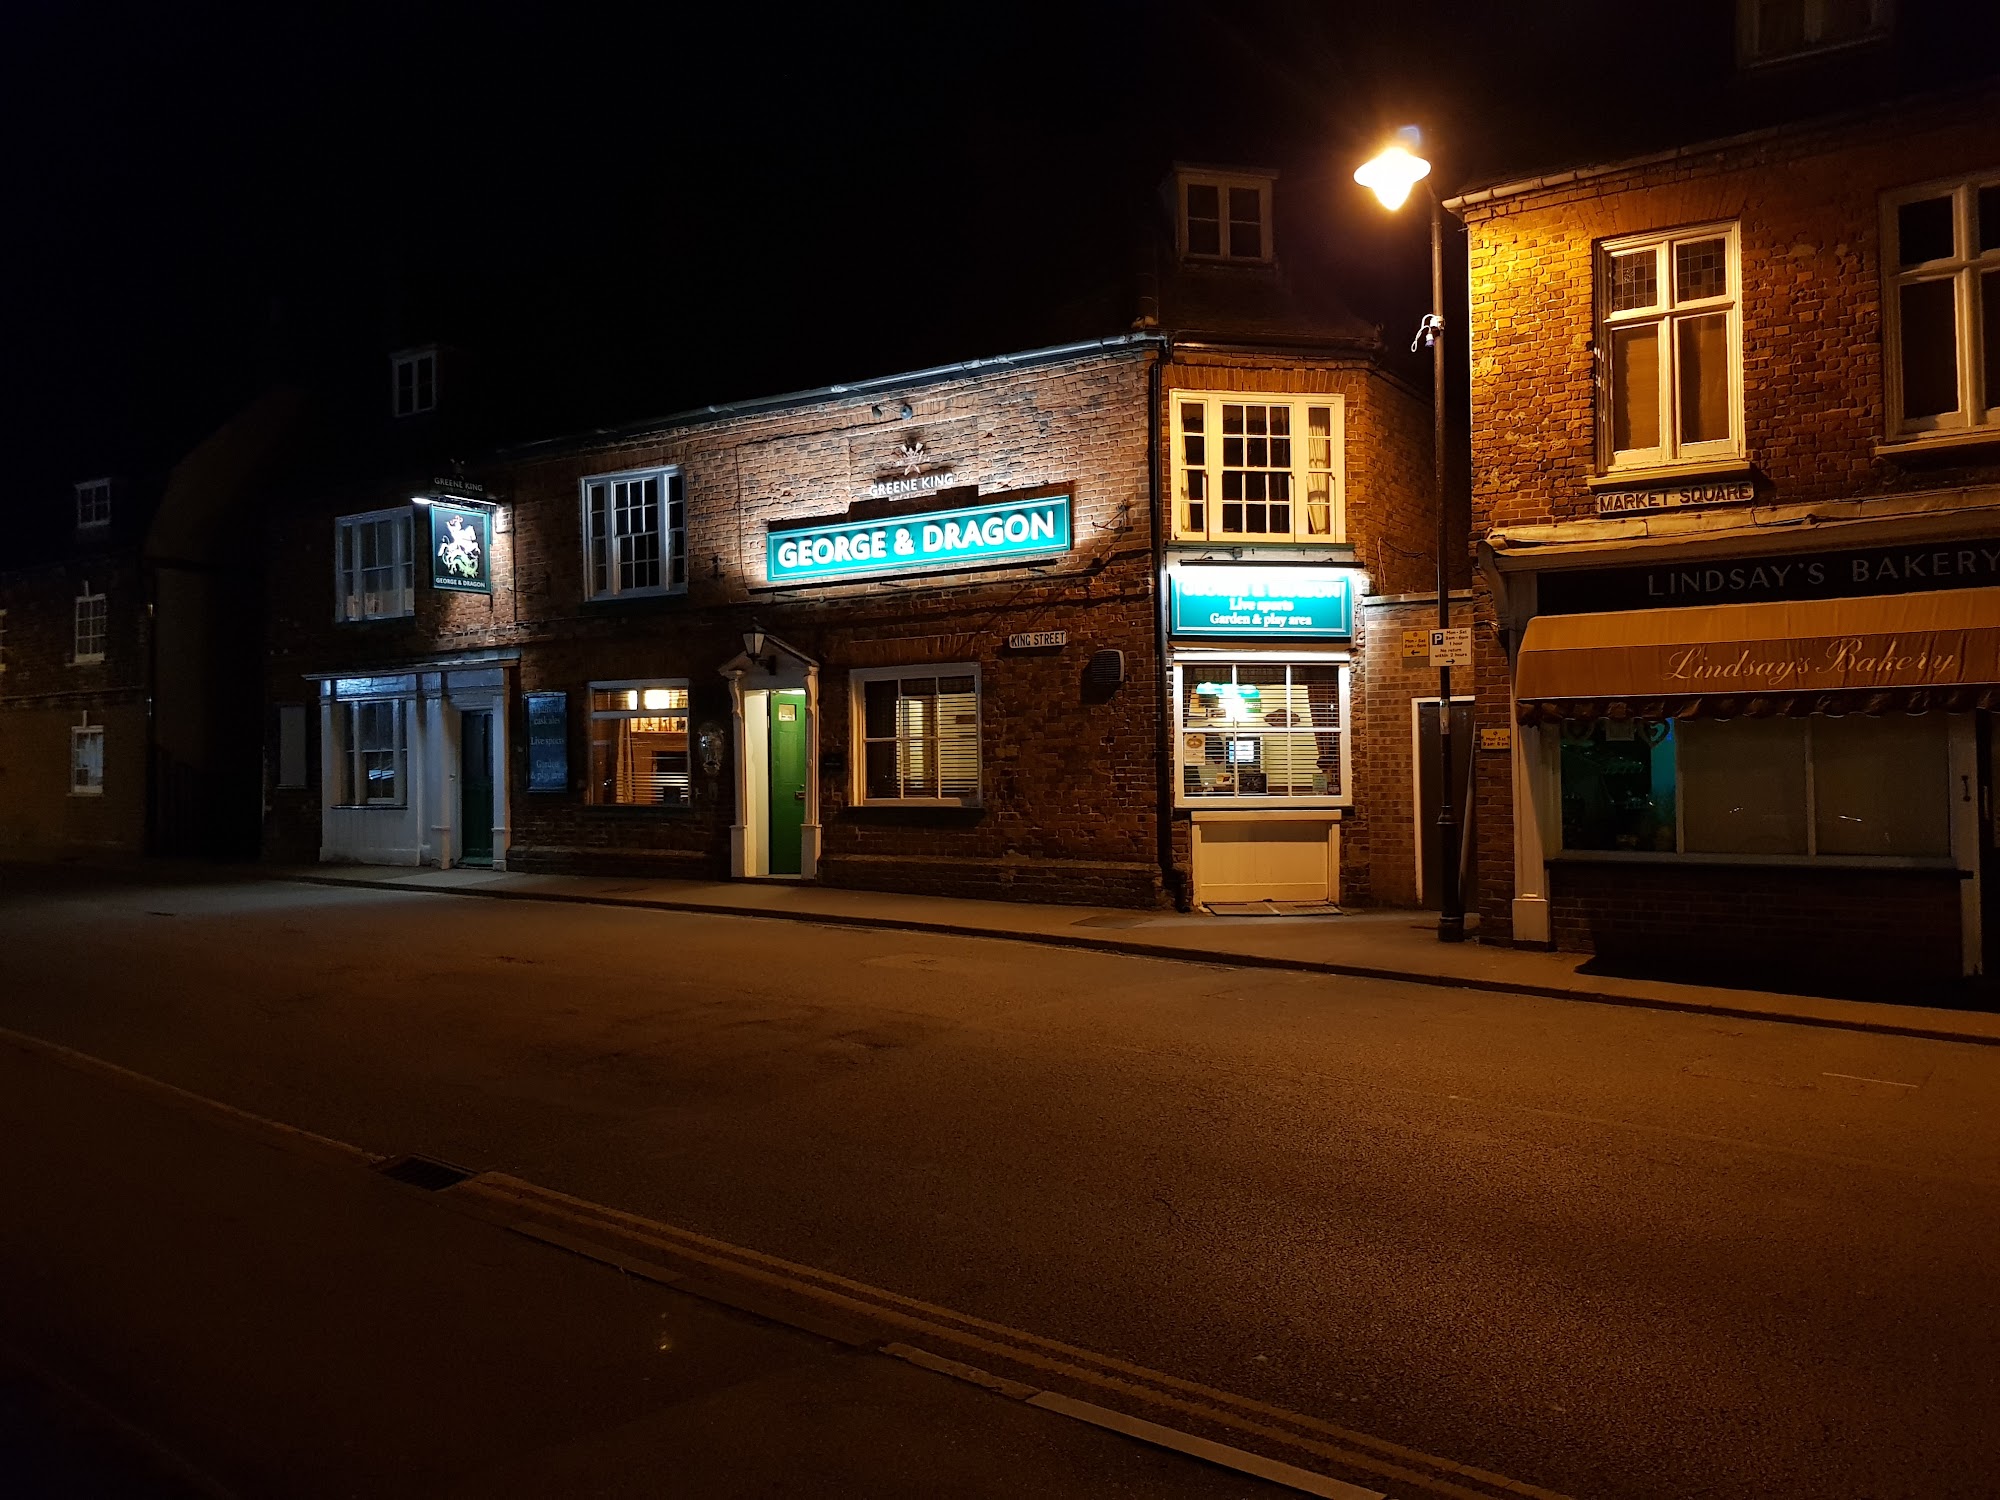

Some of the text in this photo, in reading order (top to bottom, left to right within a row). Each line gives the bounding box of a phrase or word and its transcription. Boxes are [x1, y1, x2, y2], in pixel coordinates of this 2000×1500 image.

[434, 477, 483, 492] GREENE KING
[869, 480, 917, 497] GREENE
[921, 473, 955, 490] KING
[1600, 482, 1752, 511] MARKET SQUARE
[777, 510, 1055, 568] GEORGE & DRAGON
[1648, 548, 2000, 597] LINDSAY'S BAKERY
[435, 577, 457, 586] GEORGE
[463, 579, 486, 588] DRAGON
[1229, 597, 1294, 614] Live sports
[1209, 612, 1313, 628] Garden & play area
[1010, 632, 1065, 647] KING STREET
[1661, 635, 1958, 686] Lindsay's Bakery
[530, 735, 544, 746] Live
